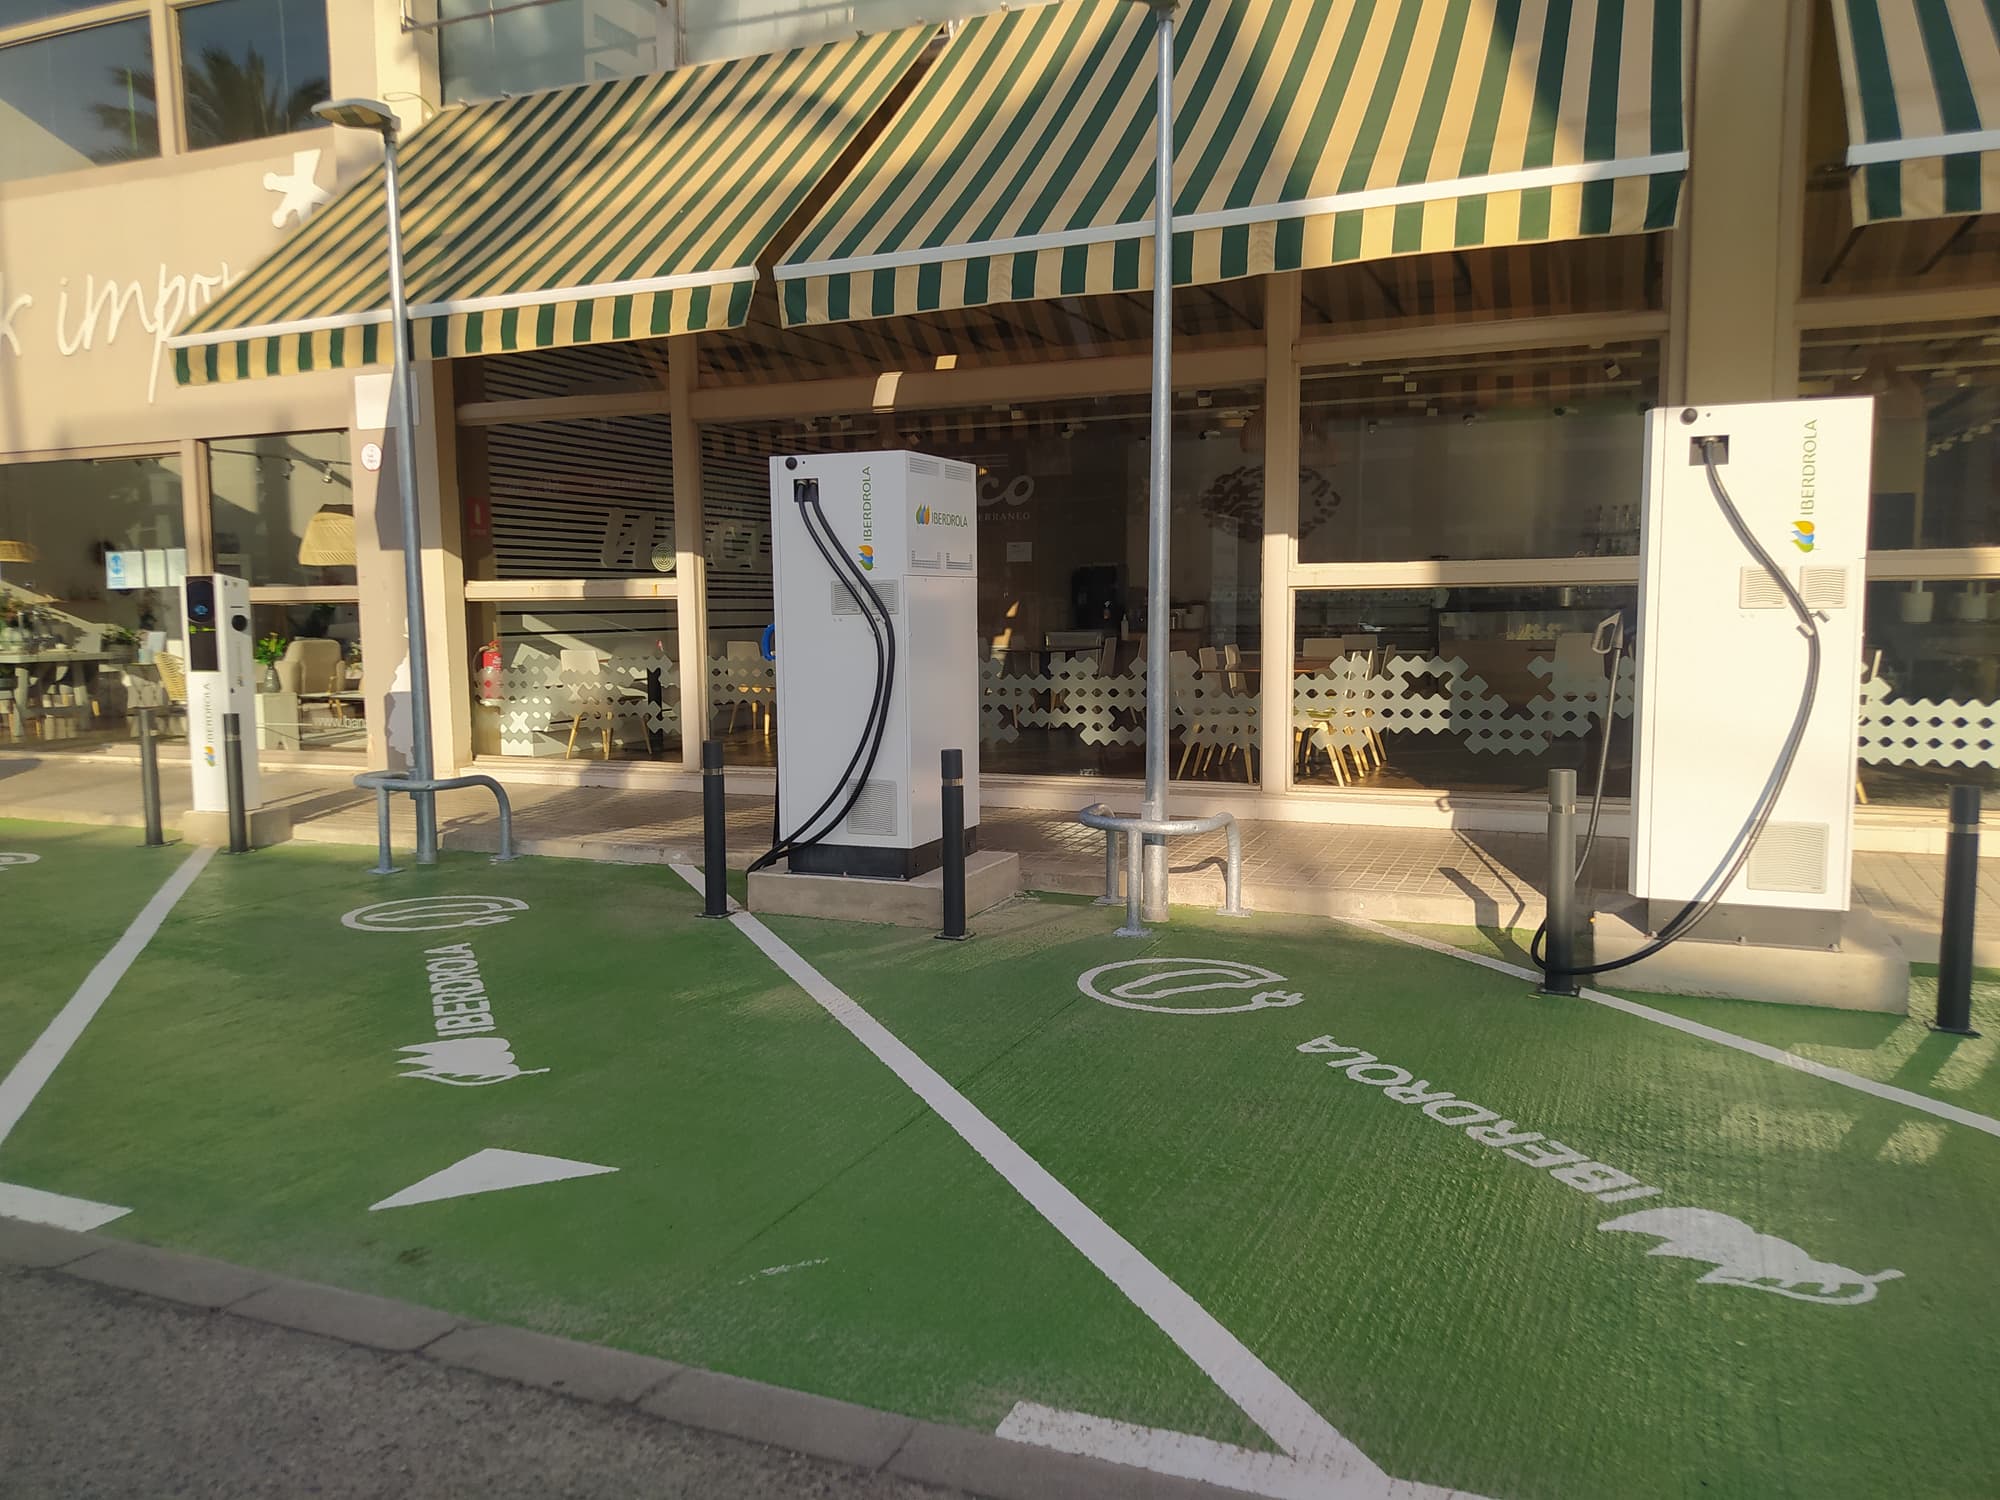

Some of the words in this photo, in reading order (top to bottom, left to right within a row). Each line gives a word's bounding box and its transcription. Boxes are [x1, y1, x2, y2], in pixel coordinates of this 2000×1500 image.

[862, 465, 873, 542] IBERDROLA
[1800, 418, 1817, 515] IBERDROLA
[931, 511, 969, 528] IBERDROLA
[424, 942, 497, 1037] IBERDROLA
[1295, 1034, 1663, 1203] IBERDROLA
